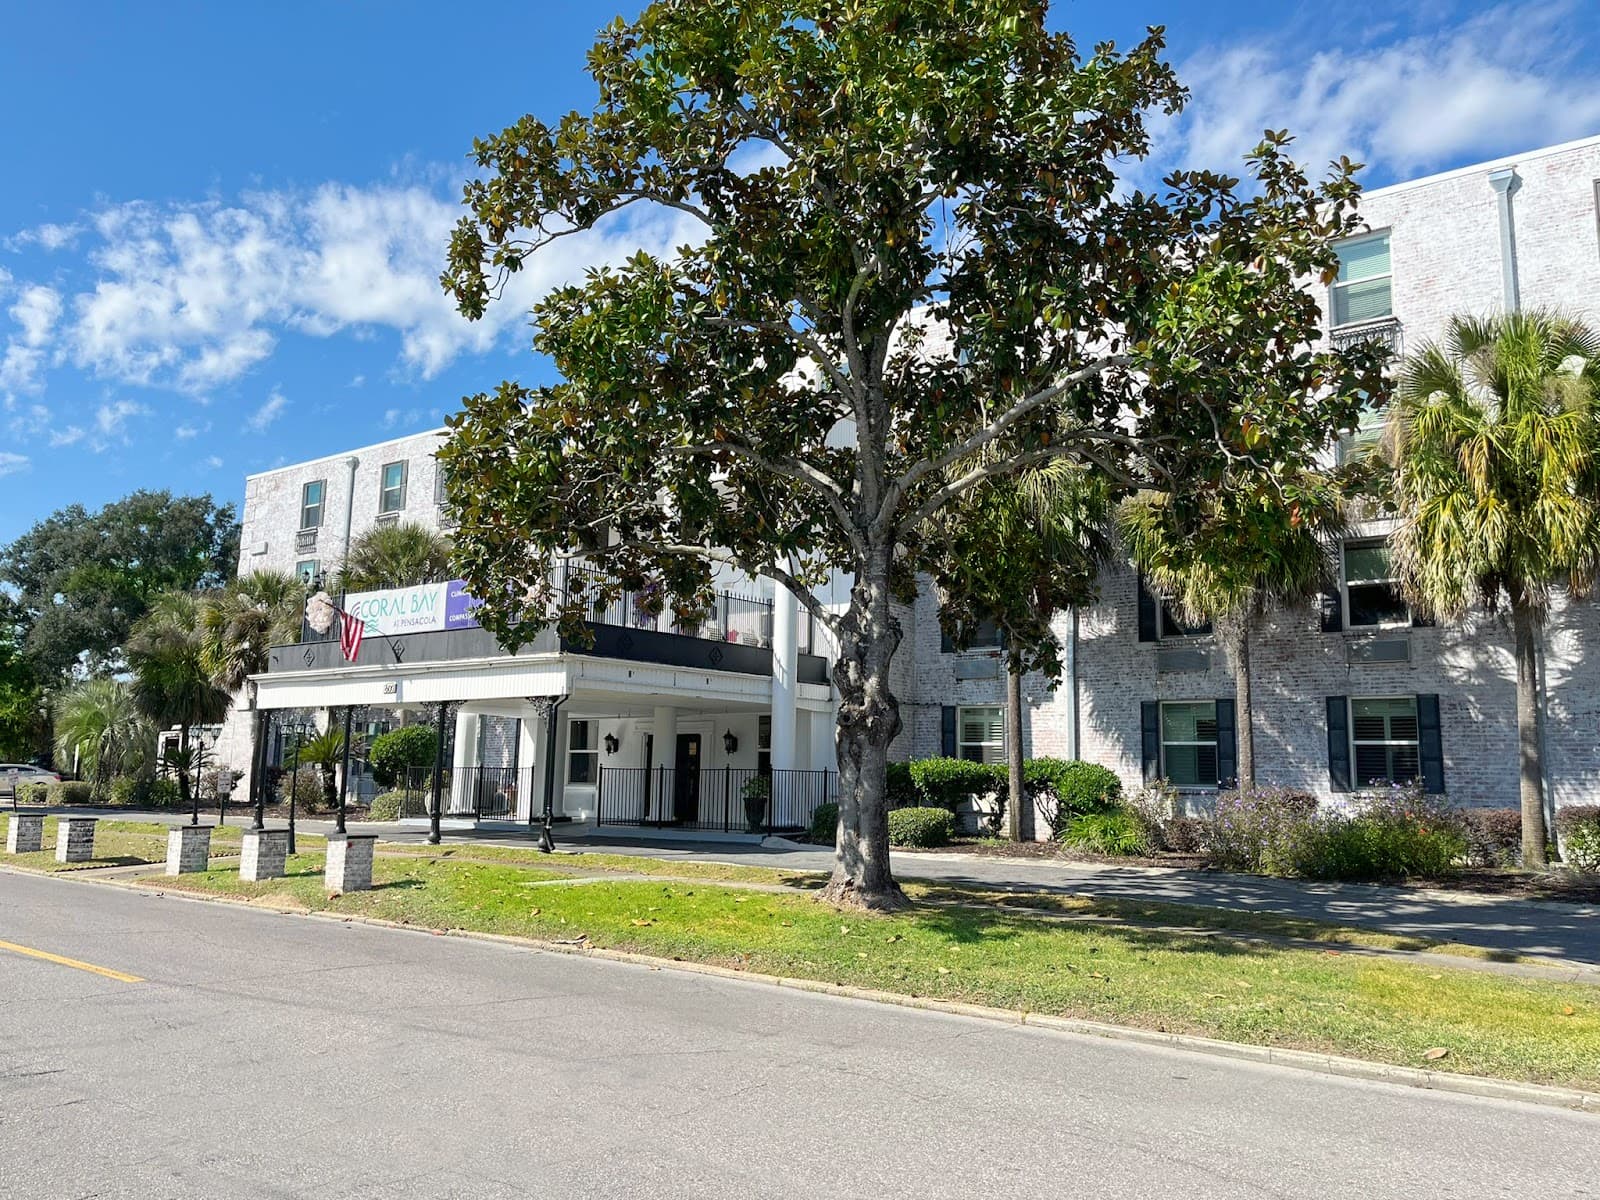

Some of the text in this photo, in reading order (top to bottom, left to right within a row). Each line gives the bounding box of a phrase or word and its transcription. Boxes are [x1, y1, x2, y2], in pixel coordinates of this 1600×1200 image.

[361, 591, 438, 618] CORAL BAY
[400, 615, 437, 627] PENSACOLA
